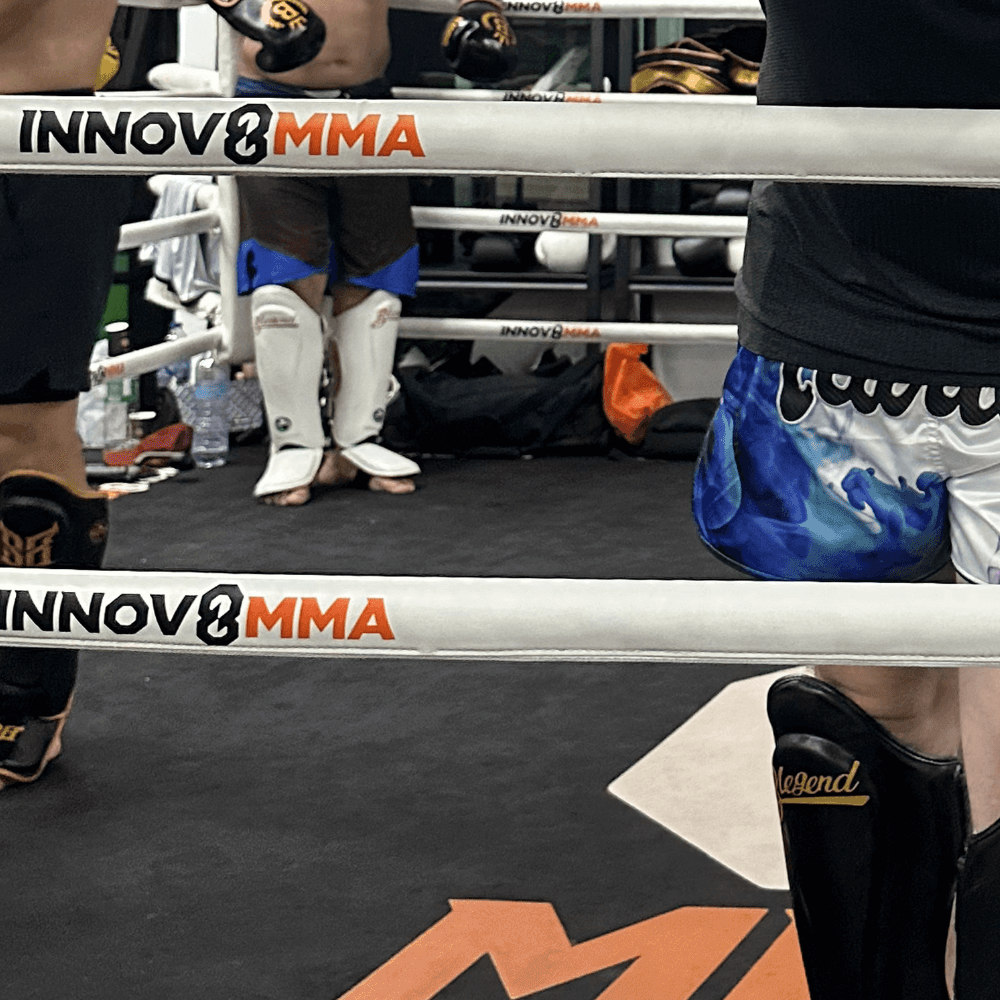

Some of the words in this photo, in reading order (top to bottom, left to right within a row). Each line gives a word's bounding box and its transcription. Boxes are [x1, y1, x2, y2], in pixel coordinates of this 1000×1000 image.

[506, 1, 602, 14] NNOV8MMA
[19, 103, 426, 165] INNOV8MMA
[775, 760, 866, 804] legend
